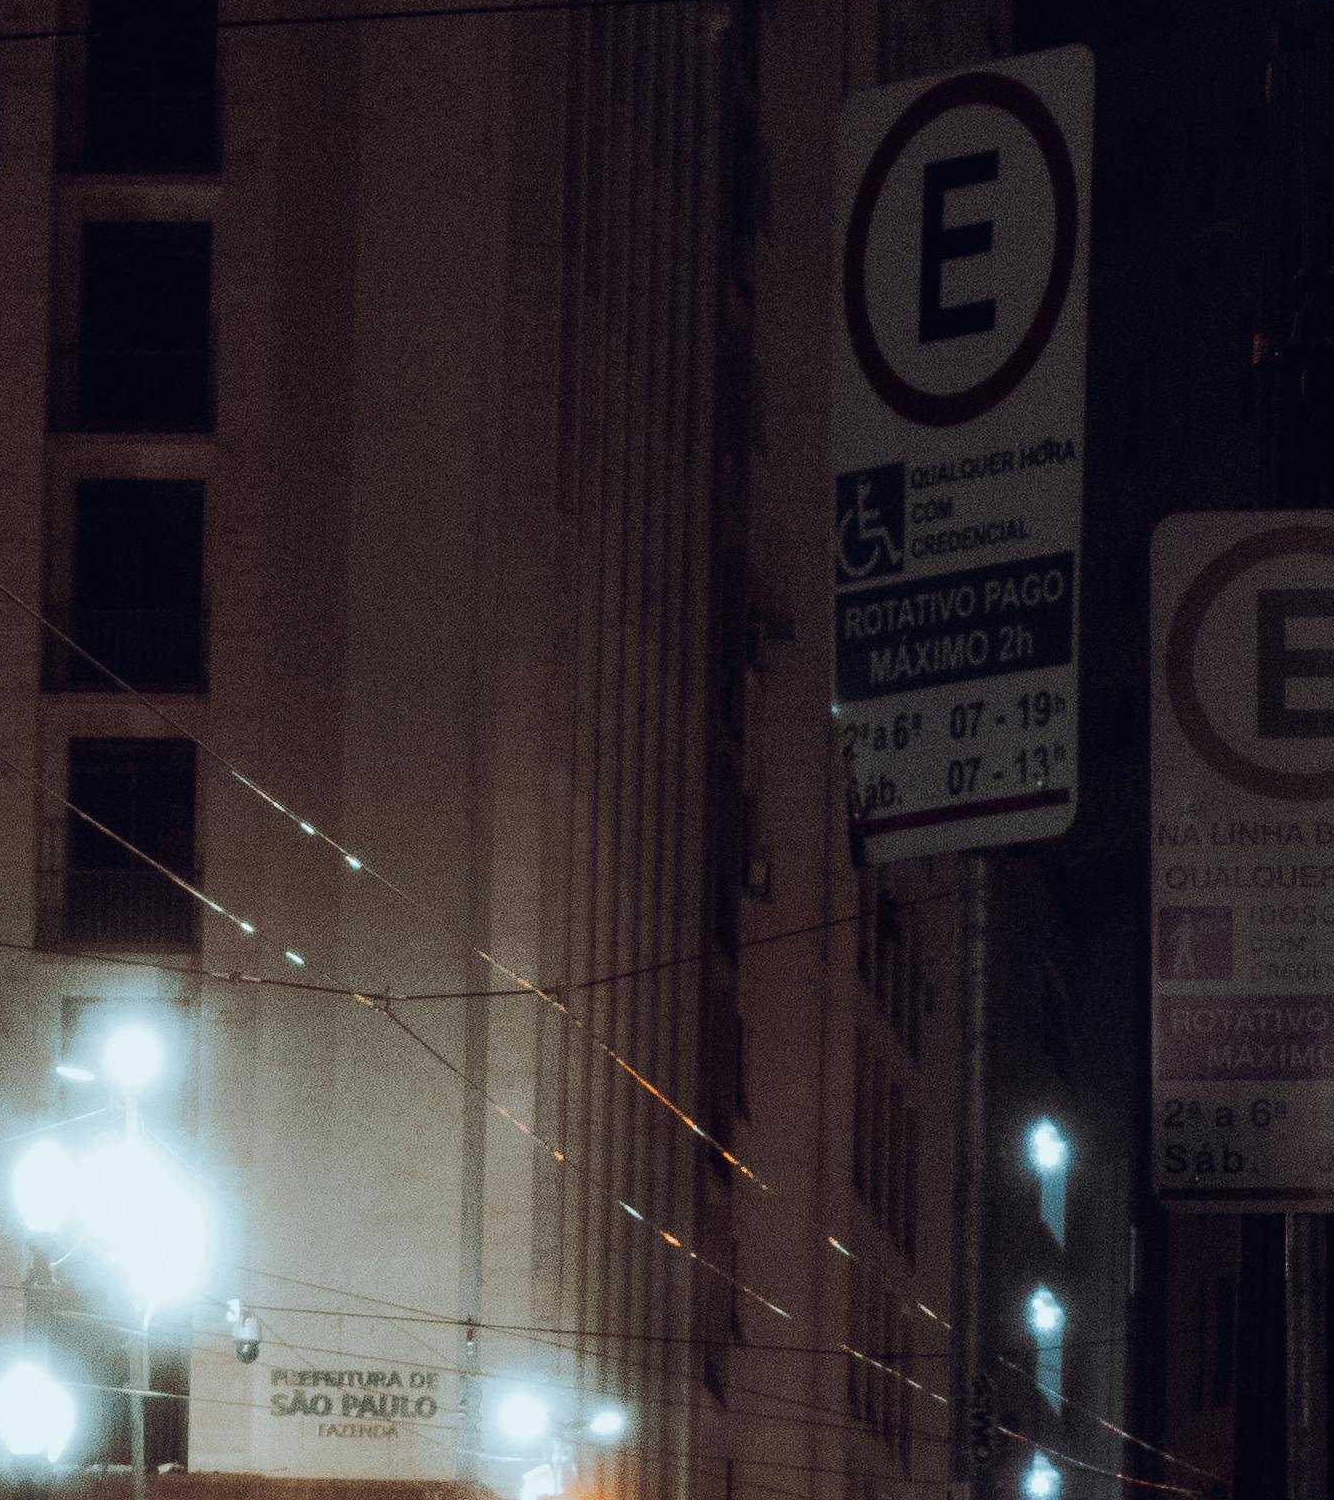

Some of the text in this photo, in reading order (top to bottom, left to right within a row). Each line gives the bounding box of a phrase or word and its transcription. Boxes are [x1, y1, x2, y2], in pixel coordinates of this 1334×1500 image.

[919, 150, 1000, 344] E
[911, 438, 1077, 490] QUALQUER HORA
[911, 498, 953, 526] COM
[911, 517, 1030, 559] CREDENCIAL
[844, 569, 1066, 641] ROTATIVO PAGO
[869, 623, 1034, 687] MÁXIMO 2h
[950, 701, 986, 740] 07
[947, 756, 983, 797] 07
[1157, 821, 1201, 847] NA
[1211, 820, 1307, 847] LINHA
[1249, 933, 1308, 954] COM
[1169, 1006, 1330, 1034] ROTATIVO
[1165, 1141, 1261, 1176] Sáb.
[270, 1368, 439, 1390] PREFEITURA DE
[270, 1388, 437, 1419] SÃO PAULO
